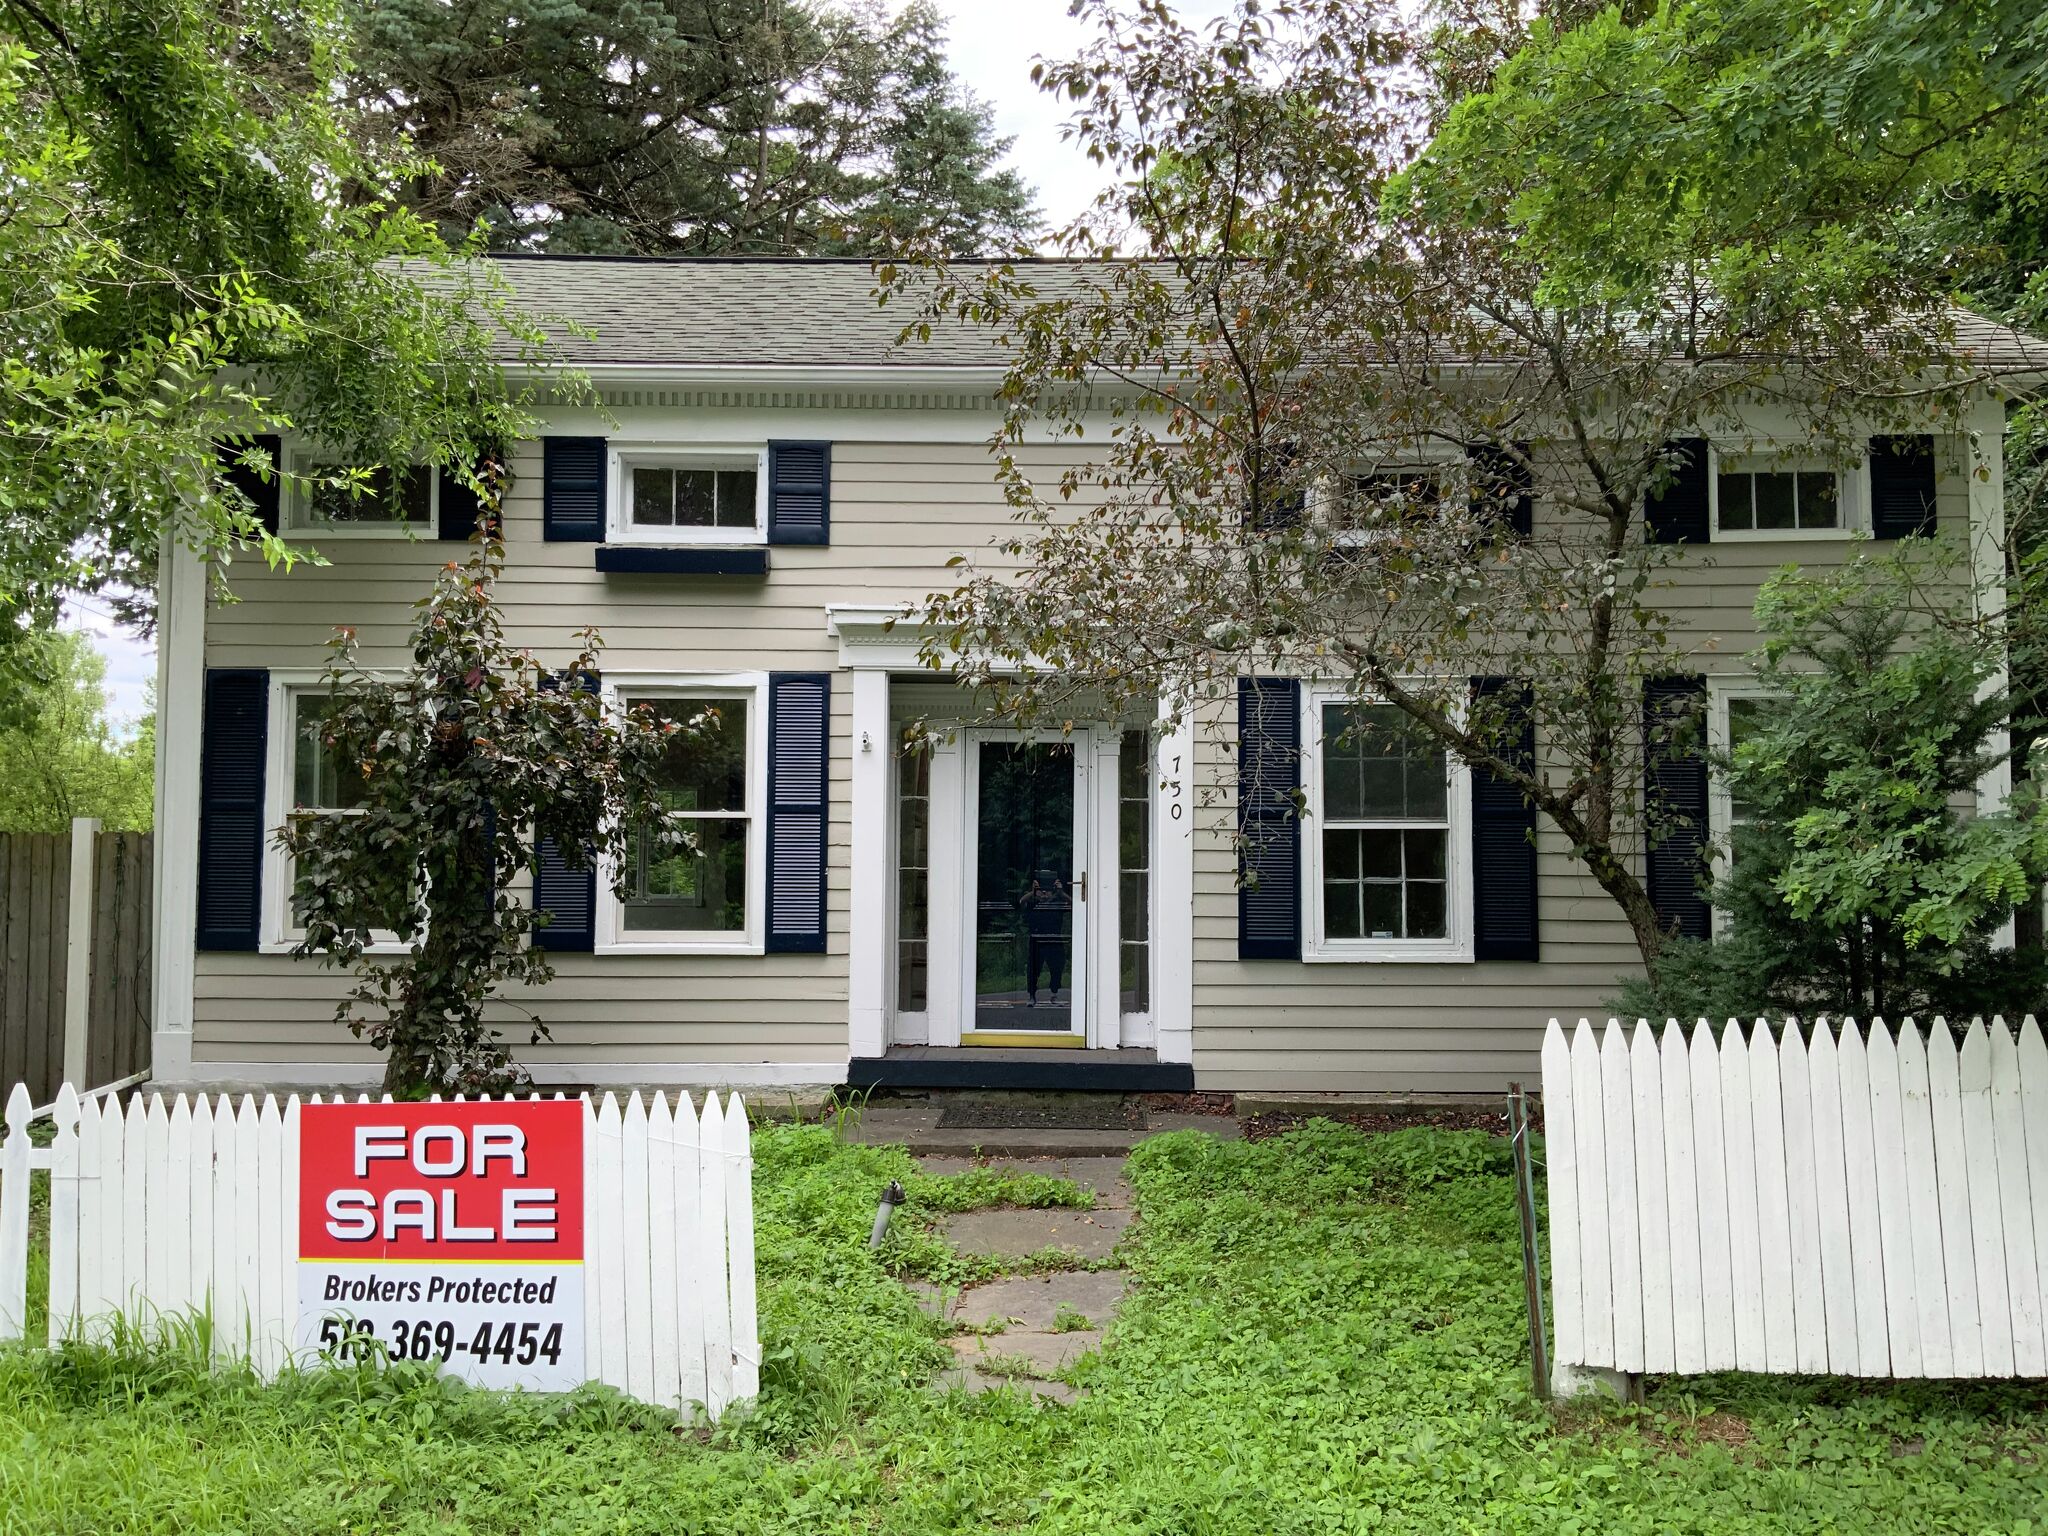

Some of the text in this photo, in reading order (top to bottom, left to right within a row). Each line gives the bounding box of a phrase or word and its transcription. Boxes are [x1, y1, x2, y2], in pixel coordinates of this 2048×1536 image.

[1171, 755, 1182, 820] 750
[354, 1124, 528, 1178] FOR
[325, 1188, 558, 1242] SALE
[323, 1274, 558, 1304] Brokers Protected
[318, 1318, 564, 1366] 518369-4454
